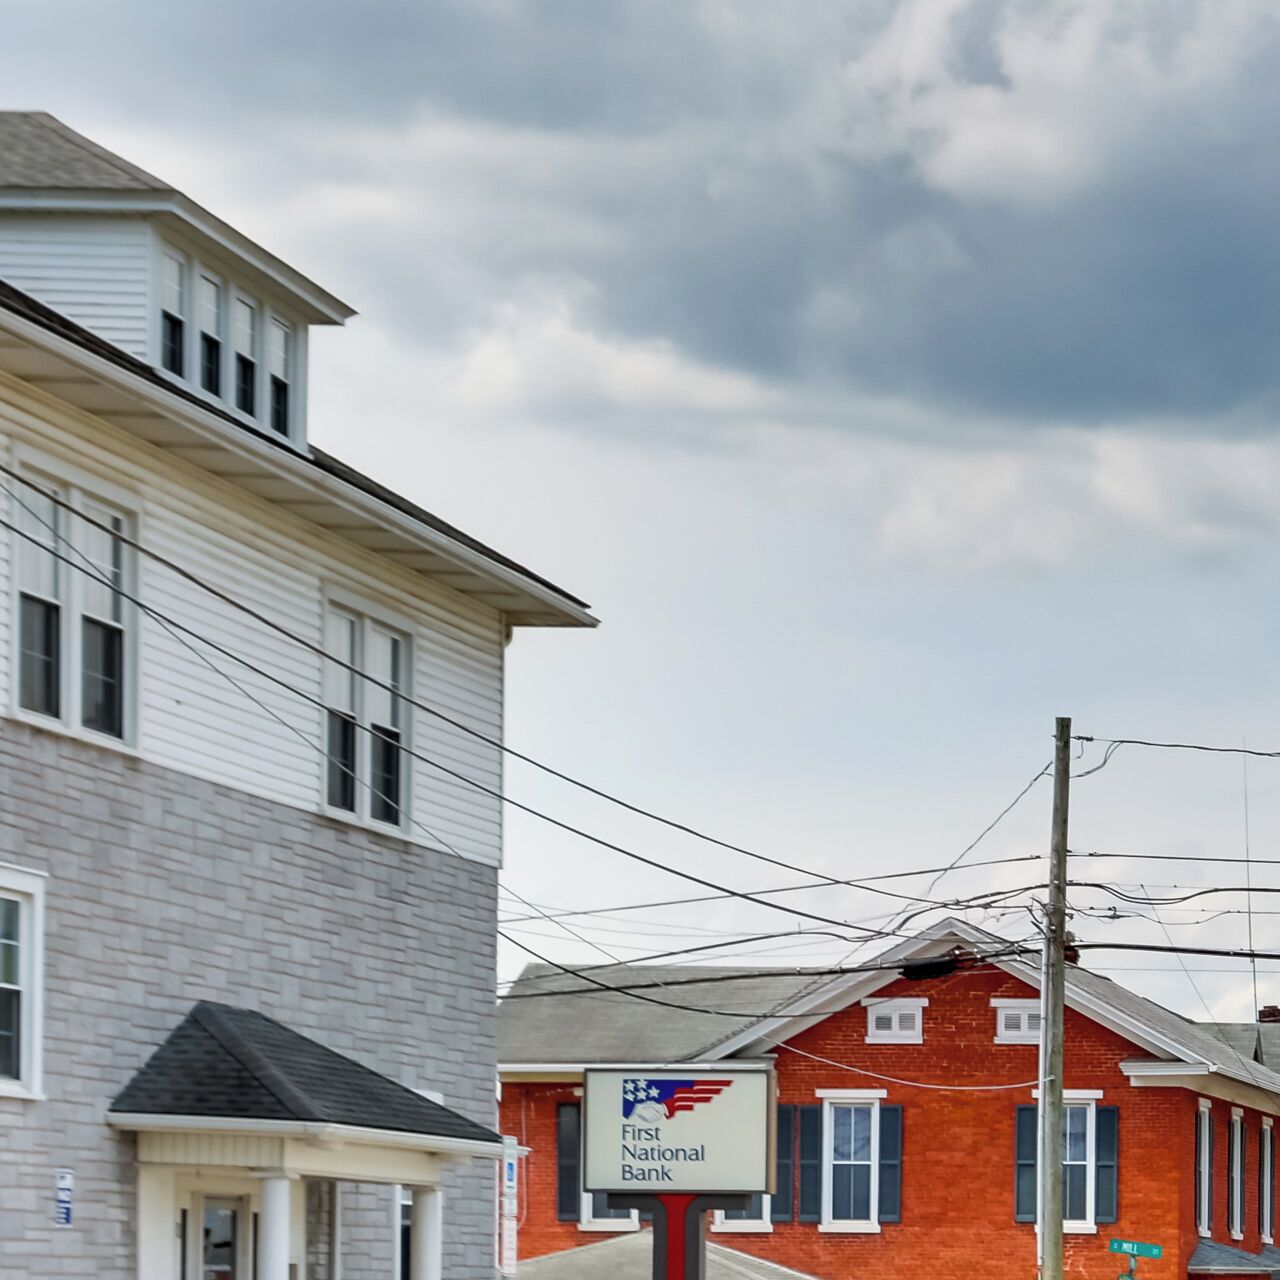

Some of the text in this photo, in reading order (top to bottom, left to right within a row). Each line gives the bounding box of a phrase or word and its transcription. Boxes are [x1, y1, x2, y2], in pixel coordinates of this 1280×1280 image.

[622, 1124, 661, 1141] First
[622, 1144, 704, 1162] National
[622, 1164, 673, 1181] Bank
